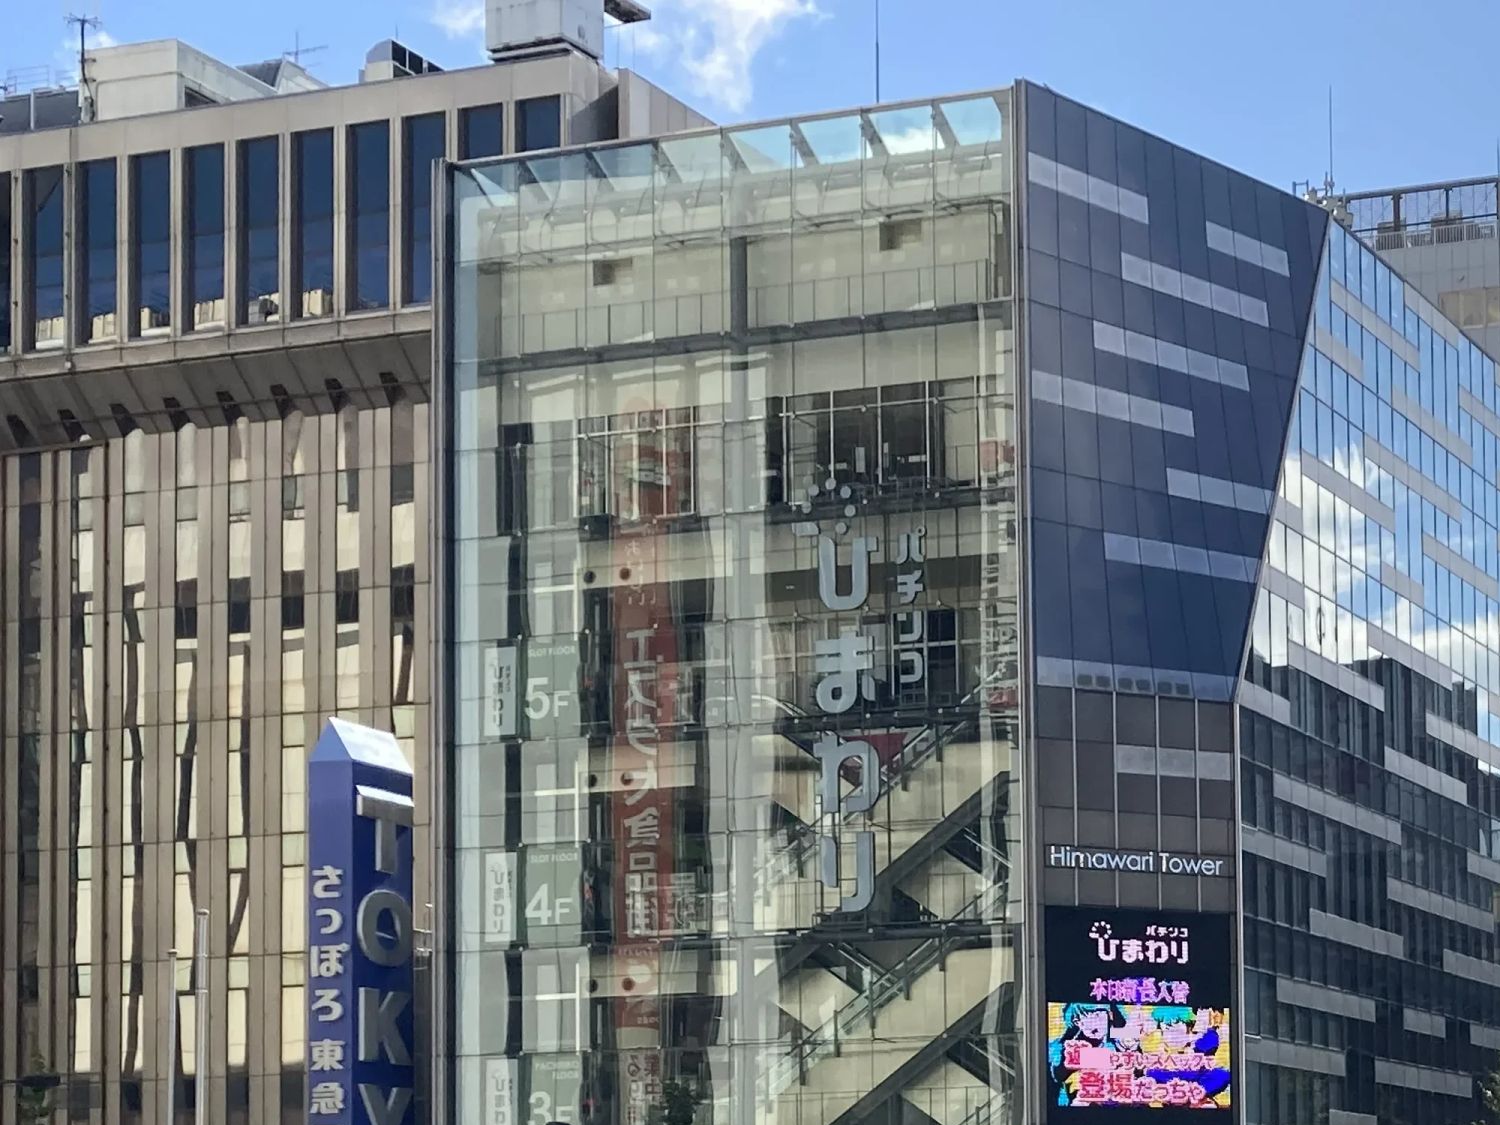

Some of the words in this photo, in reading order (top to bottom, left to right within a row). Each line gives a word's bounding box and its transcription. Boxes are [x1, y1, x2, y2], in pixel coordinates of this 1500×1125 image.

[895, 526, 928, 684] パチンコ
[524, 676, 571, 720] 5F
[793, 520, 882, 915] ひまわり
[1049, 845, 1154, 872] Himawari
[1158, 852, 1224, 876] Tower
[524, 883, 573, 925] 4F
[1090, 932, 1190, 965] ひまわり
